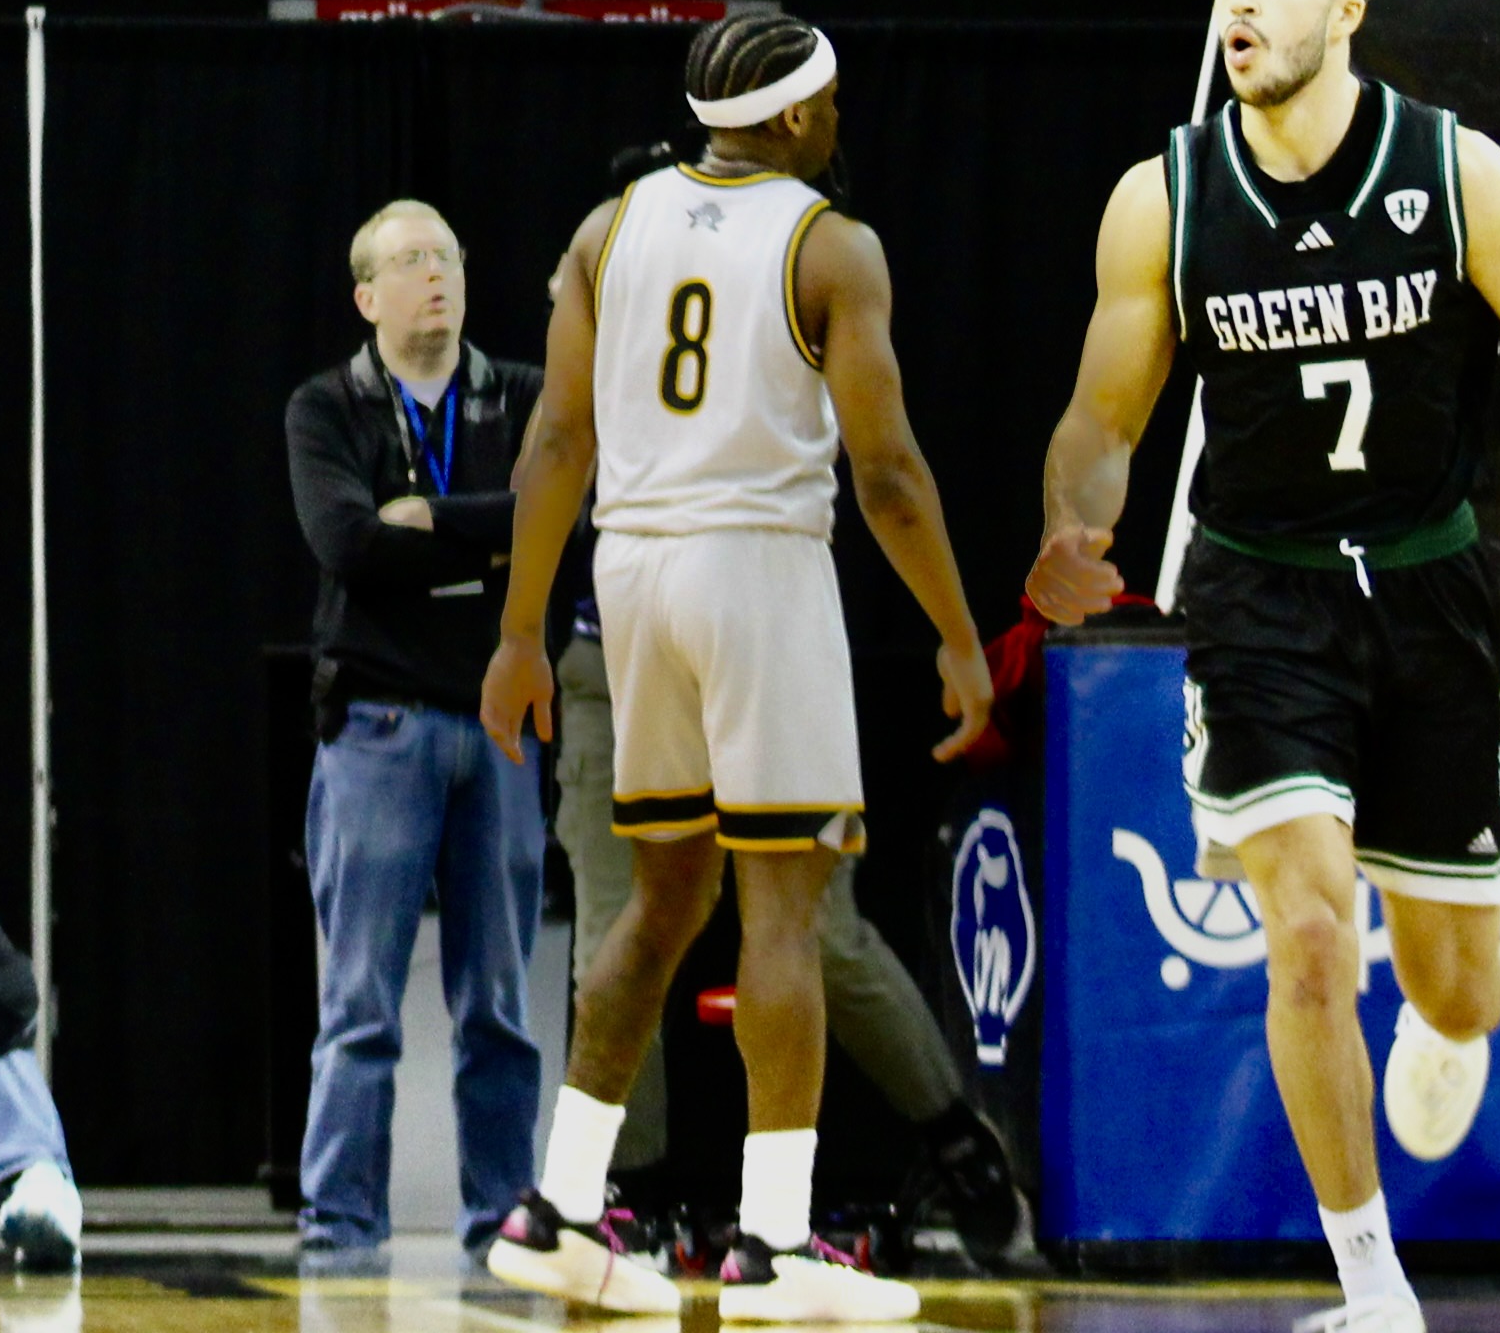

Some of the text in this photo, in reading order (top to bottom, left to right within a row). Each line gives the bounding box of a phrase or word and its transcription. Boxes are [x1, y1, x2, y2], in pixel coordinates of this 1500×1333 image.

[658, 276, 715, 416] 8
[1205, 269, 1438, 352] GREEN BAY
[1299, 358, 1373, 471] 7
